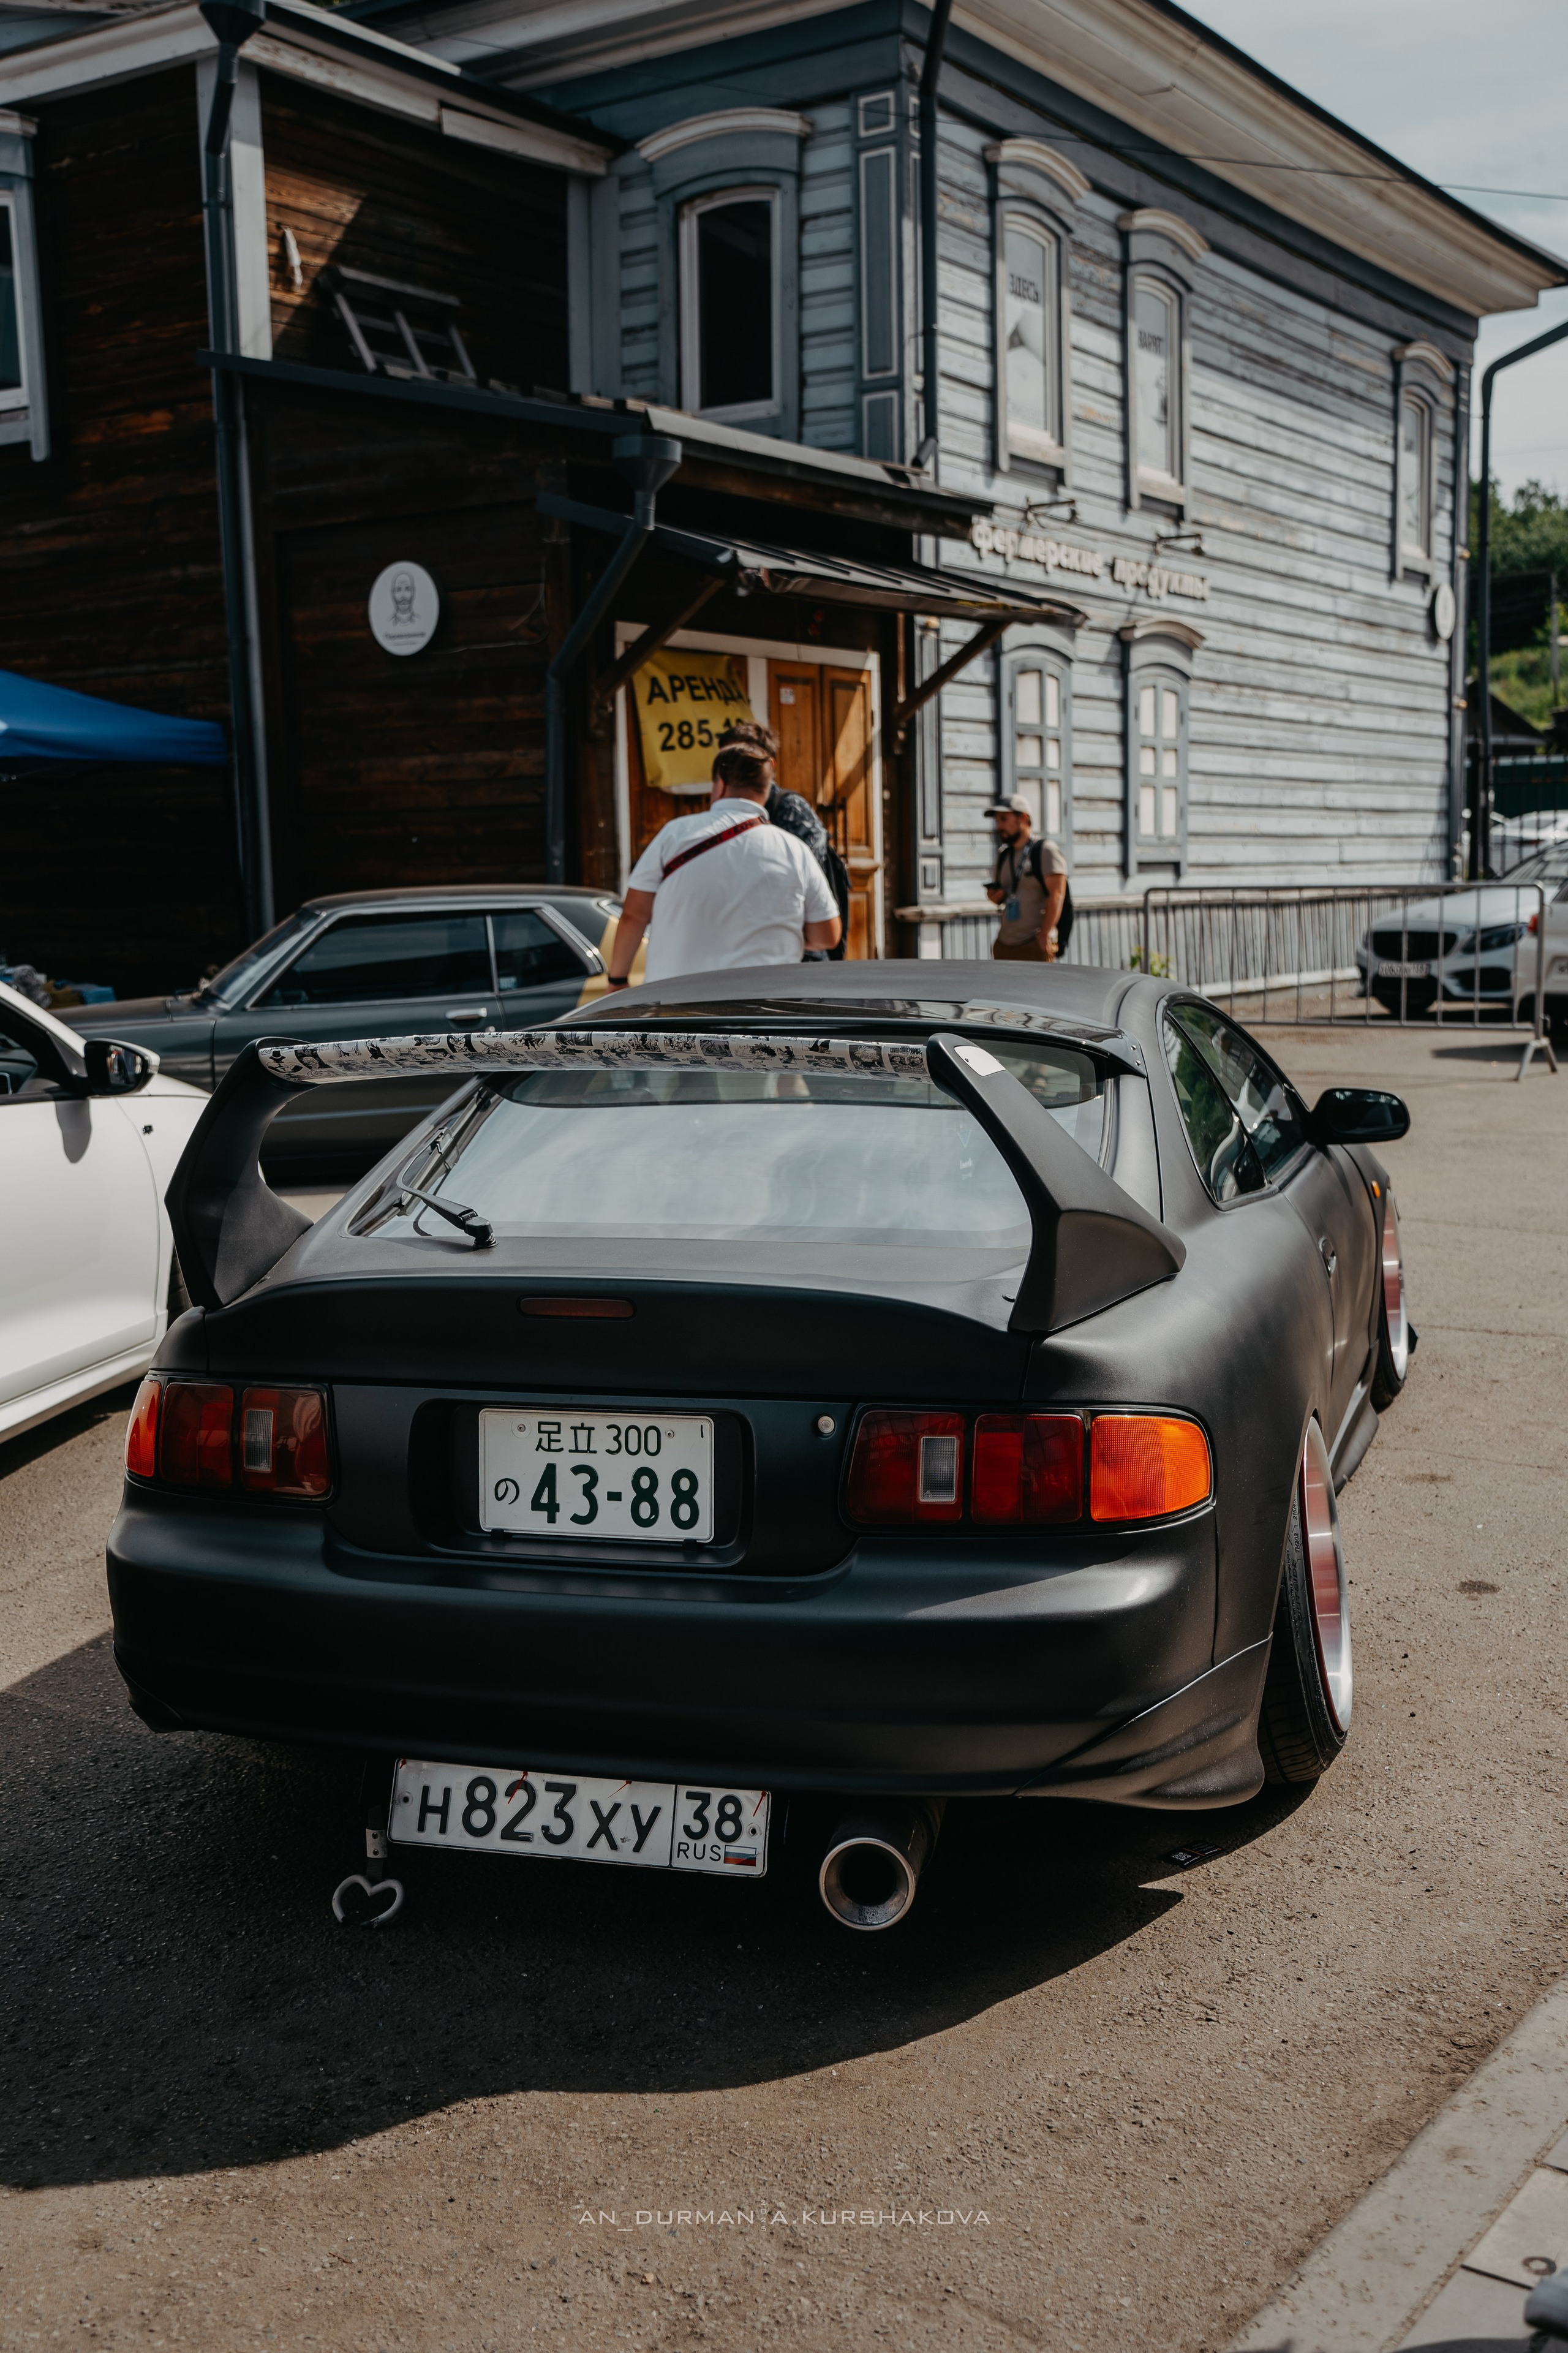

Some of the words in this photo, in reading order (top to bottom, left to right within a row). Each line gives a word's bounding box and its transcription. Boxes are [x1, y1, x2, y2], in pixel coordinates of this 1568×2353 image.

[531, 1463, 699, 1530] 43-88
[1292, 1558, 1302, 1622] OUTSIDE
[682, 1791, 743, 1843] 38
[677, 1842, 722, 1862] RUS
